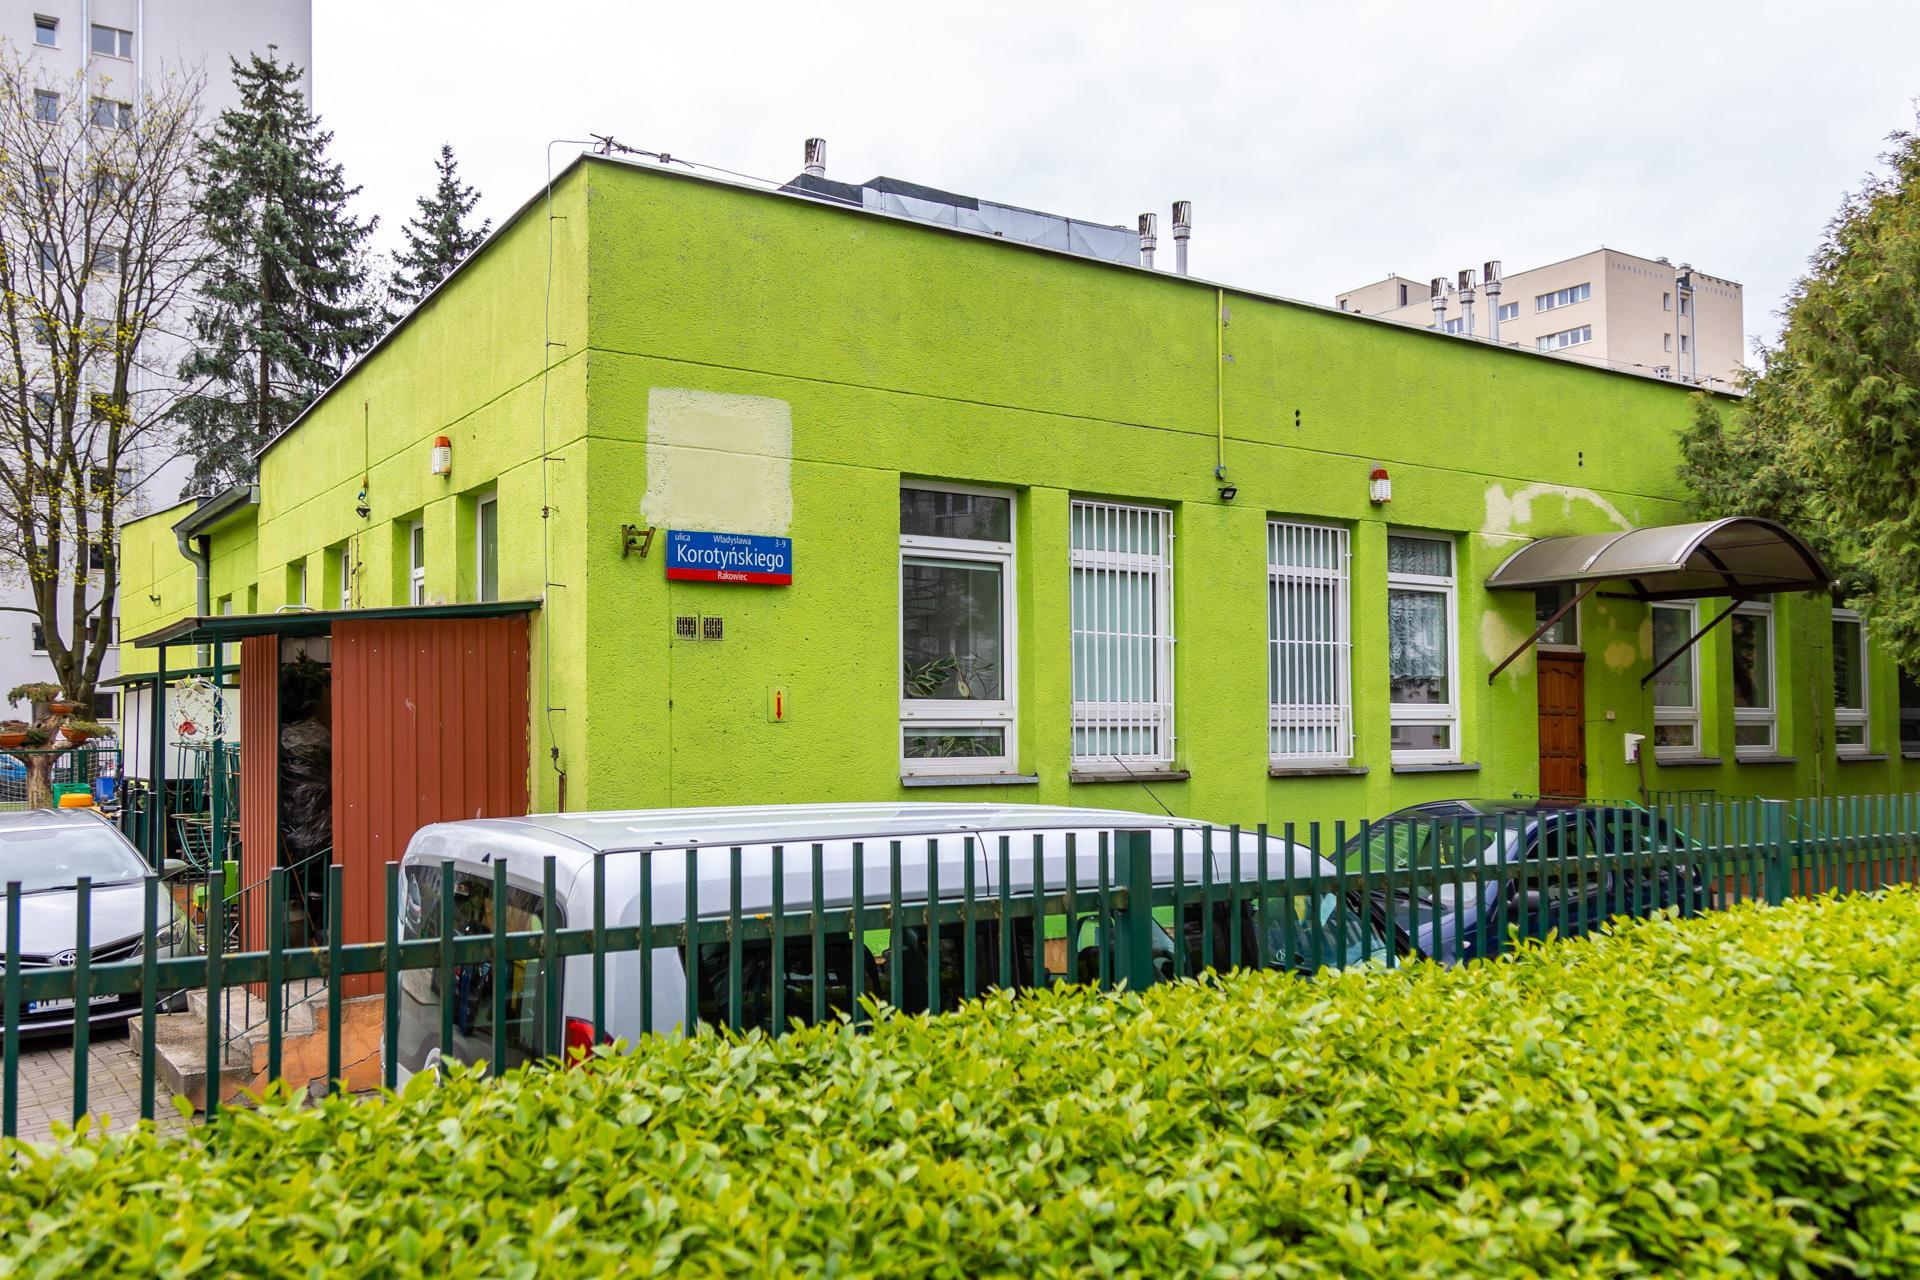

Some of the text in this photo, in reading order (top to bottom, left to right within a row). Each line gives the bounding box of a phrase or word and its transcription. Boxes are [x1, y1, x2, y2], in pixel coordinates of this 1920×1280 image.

[674, 533, 787, 548] ulica Władysława 3-9
[677, 544, 784, 572] Korotyńskiego
[717, 571, 748, 581] Rakowiec
